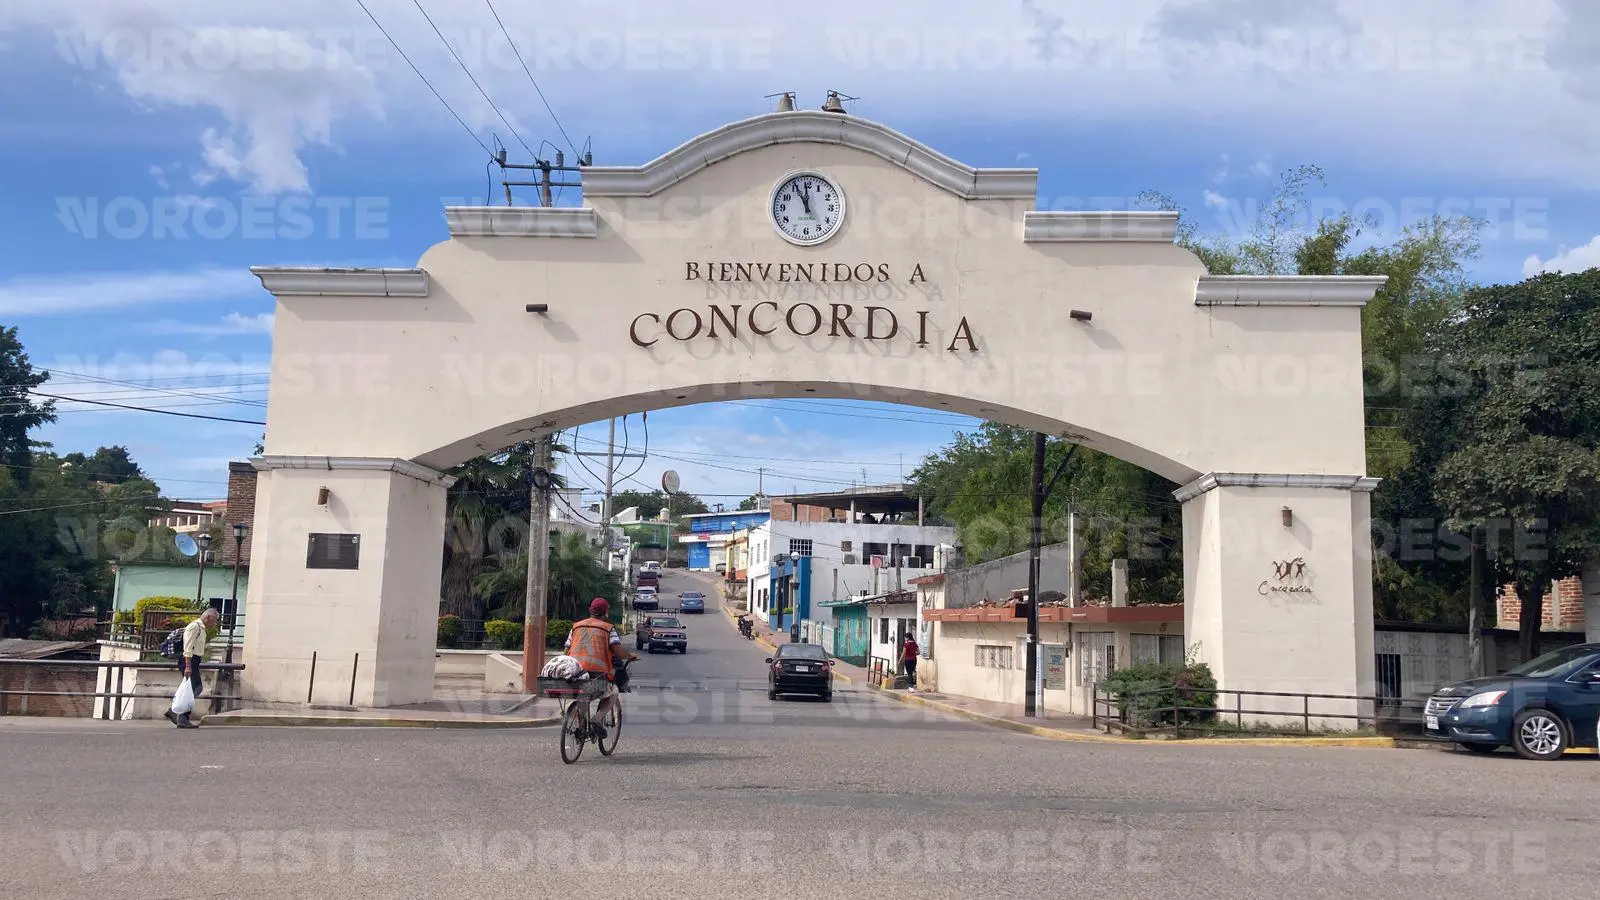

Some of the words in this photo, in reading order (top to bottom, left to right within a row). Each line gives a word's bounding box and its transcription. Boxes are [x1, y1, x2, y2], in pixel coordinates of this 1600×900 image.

[783, 193, 791, 201] 10
[825, 193, 831, 201] 2
[828, 204, 834, 212] 3
[803, 227, 809, 235] 6
[816, 224, 822, 232] 5
[685, 262, 890, 283] BIENVENIDOS
[909, 263, 926, 283] A
[629, 301, 979, 352] CONCORDIA
